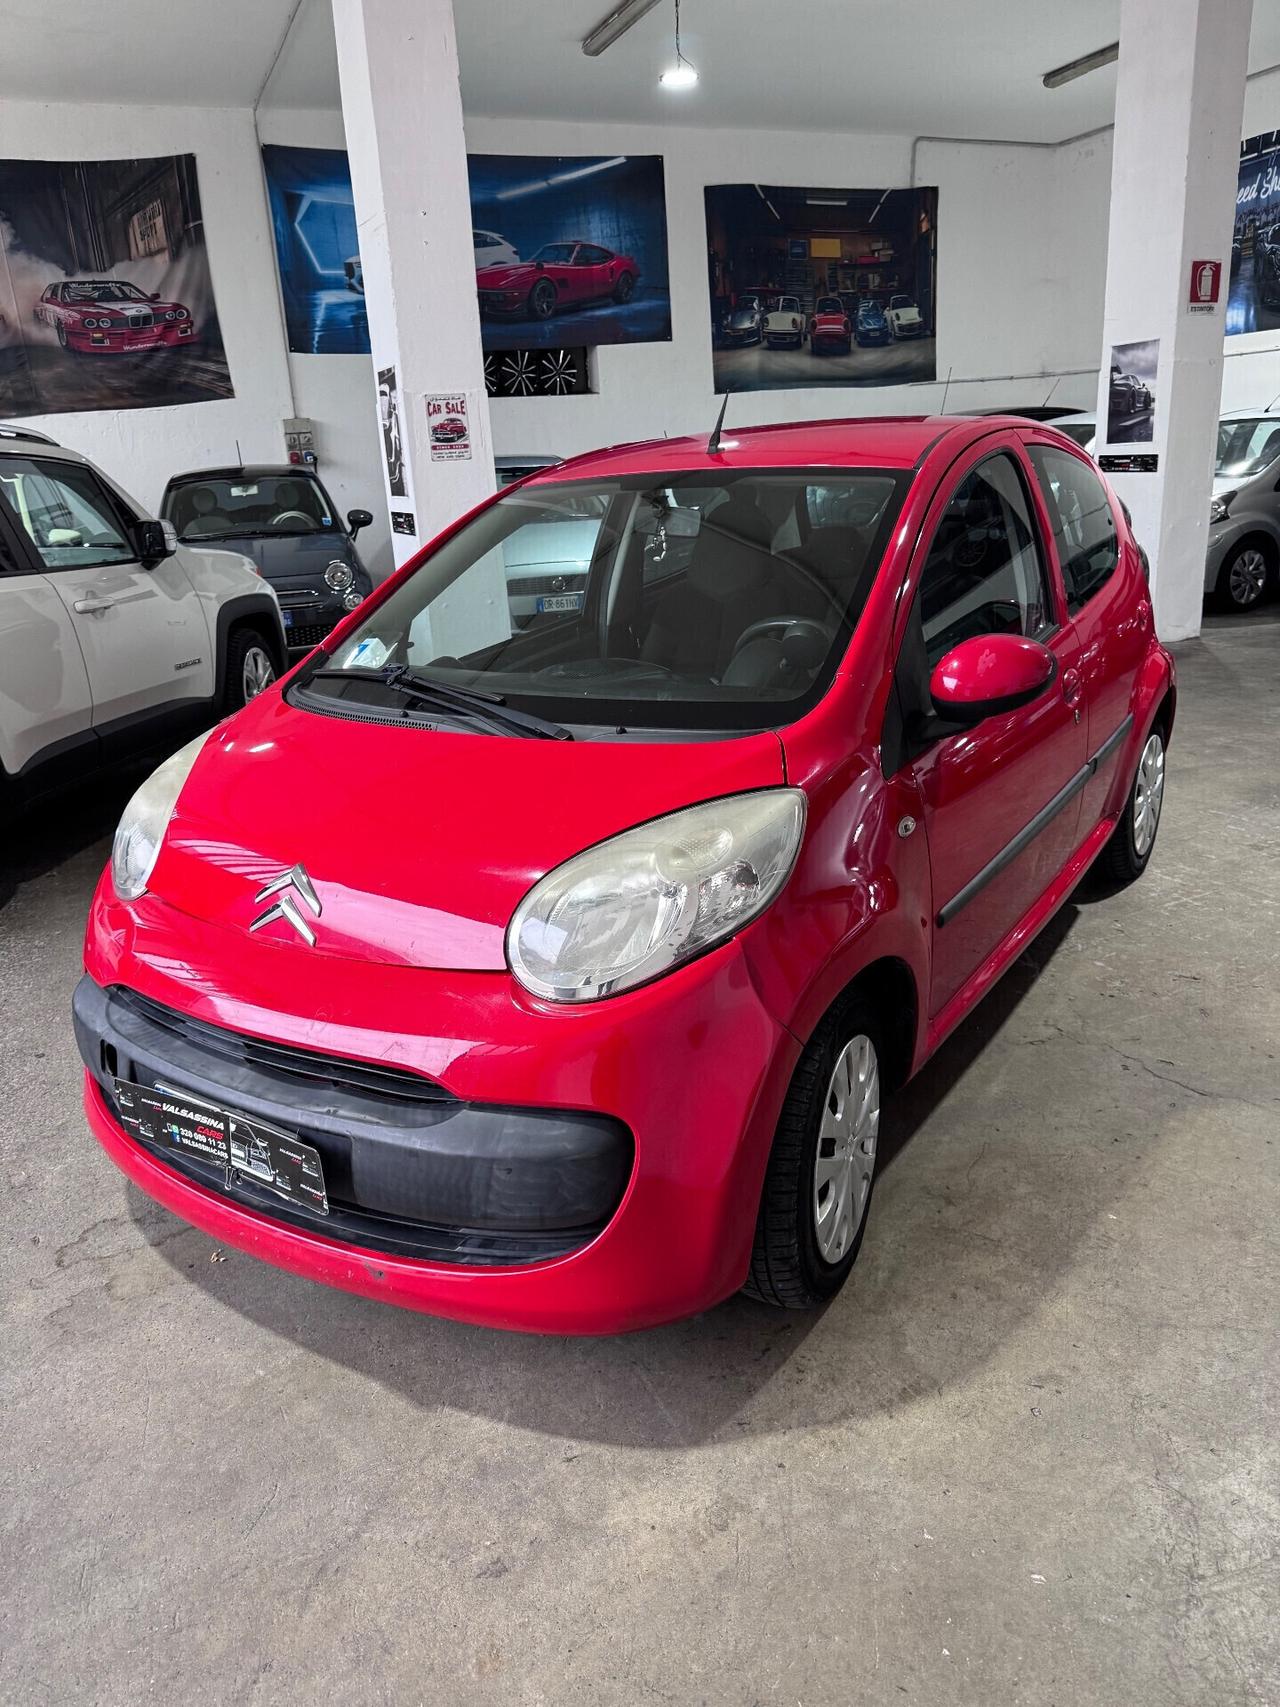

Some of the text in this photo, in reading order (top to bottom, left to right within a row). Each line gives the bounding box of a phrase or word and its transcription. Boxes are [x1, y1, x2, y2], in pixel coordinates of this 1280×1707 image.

[1236, 172, 1261, 204] eed
[427, 400, 466, 417] CAR SALE
[162, 1103, 225, 1131] VALSASSINA
[196, 1125, 224, 1140] CARS
